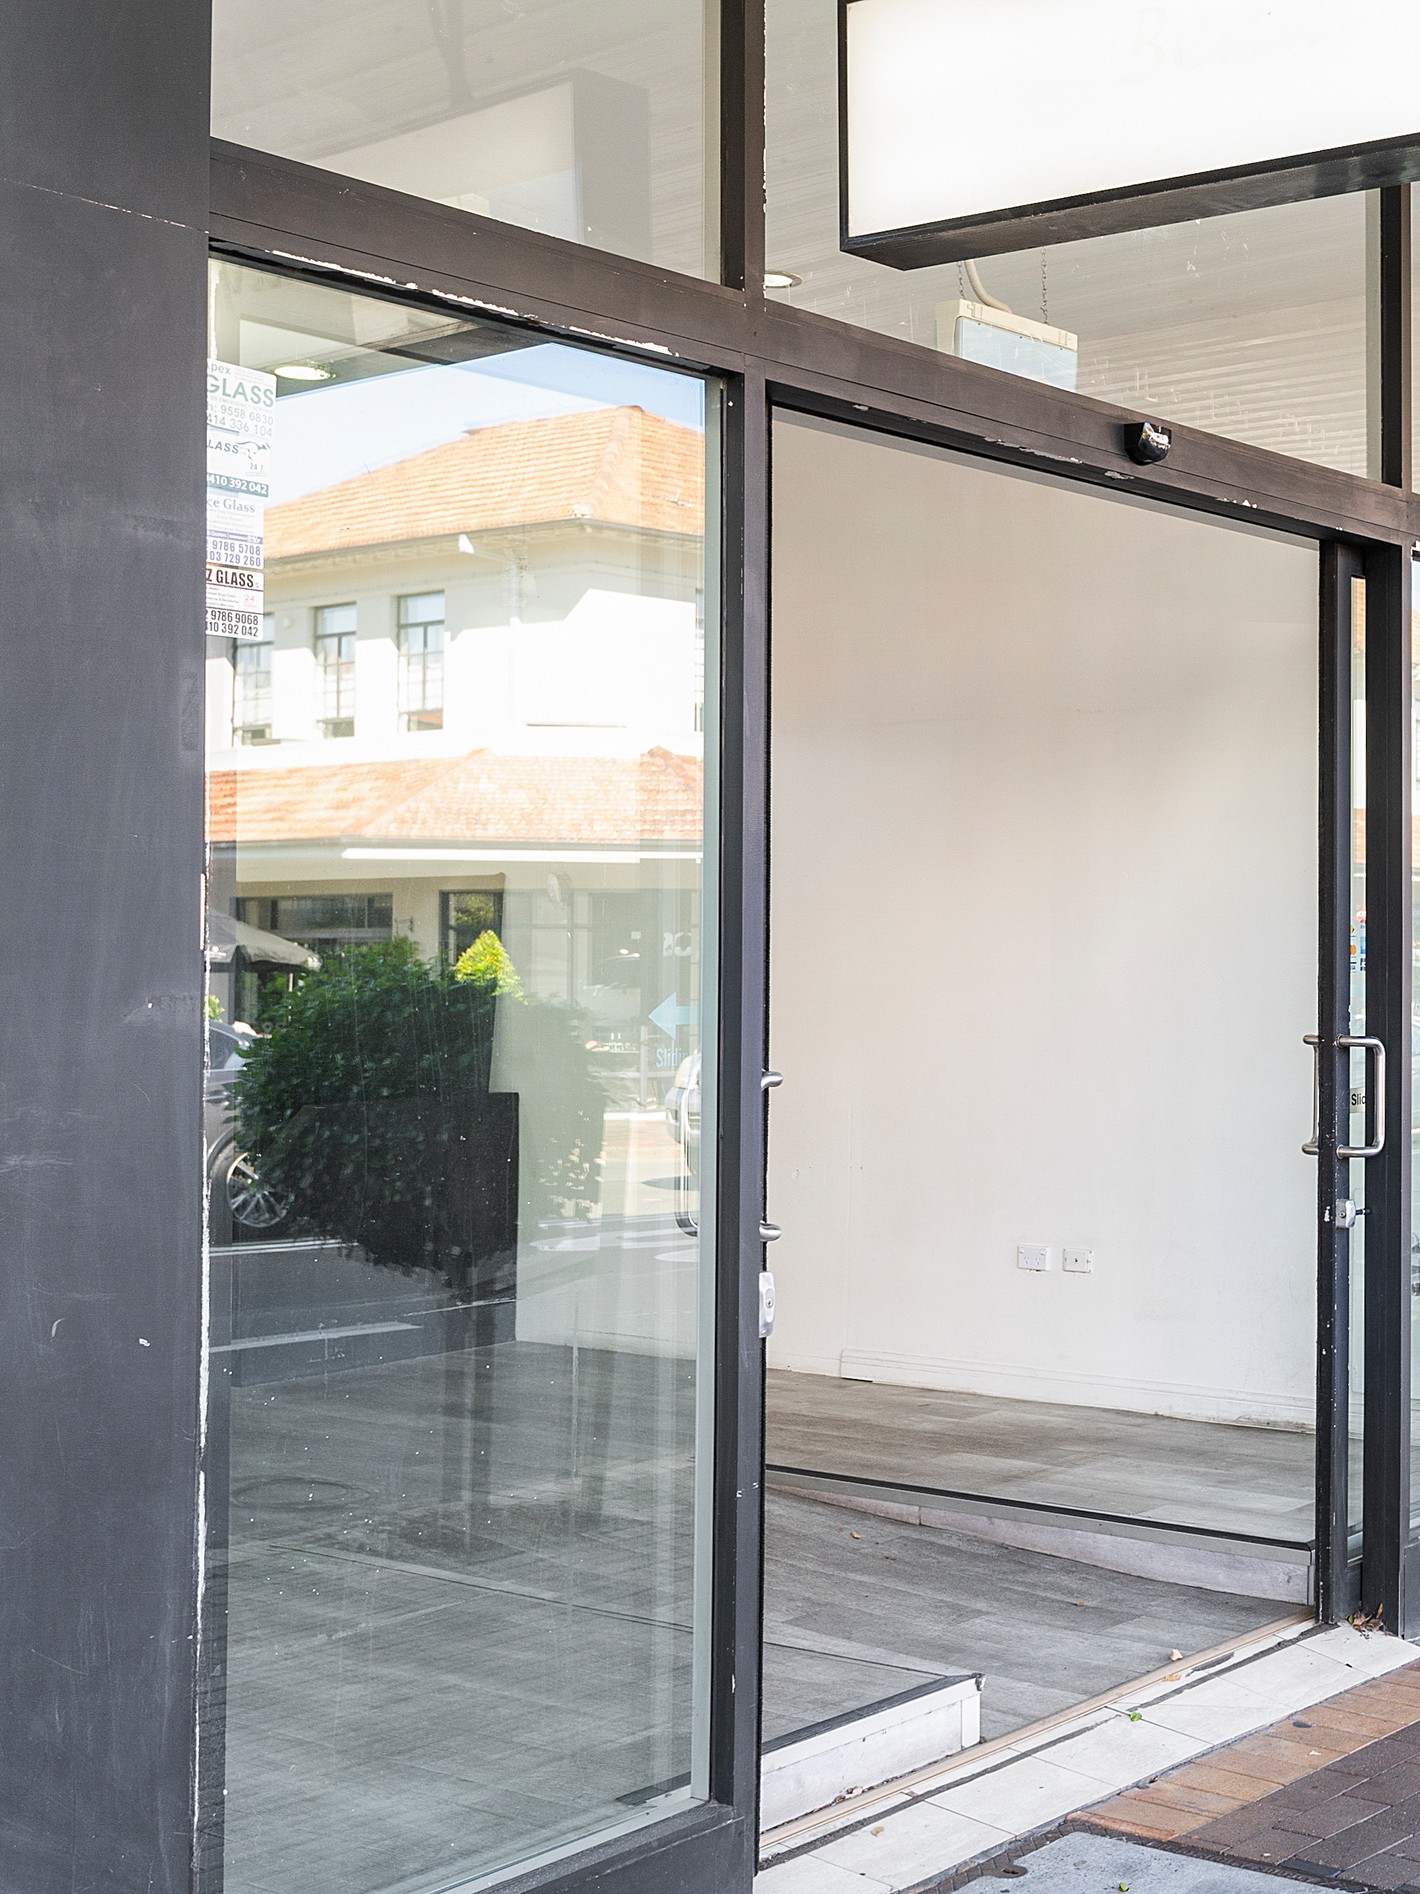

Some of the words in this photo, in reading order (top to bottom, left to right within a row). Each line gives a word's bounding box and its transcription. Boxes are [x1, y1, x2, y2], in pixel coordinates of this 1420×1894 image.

[207, 363, 231, 375] pex
[207, 374, 274, 407] GLASS
[220, 404, 246, 420] 9558
[249, 411, 274, 426] 6830
[207, 413, 226, 426] 414
[229, 418, 250, 433] 336
[254, 424, 273, 437] 104
[207, 439, 239, 454] LASS
[208, 474, 228, 486] 410
[229, 478, 248, 490] 392
[249, 482, 267, 495] 042
[207, 498, 220, 508] ce
[223, 498, 256, 513] Glass
[212, 539, 236, 552] 9786
[238, 543, 261, 556] 5708
[209, 550, 221, 562] 03
[224, 552, 241, 564] 729
[243, 555, 261, 567] 260
[216, 569, 254, 588] GLASS
[210, 610, 233, 622] 9786
[235, 612, 259, 626] 9068
[209, 621, 219, 632] 10
[221, 622, 239, 635] 392
[241, 625, 259, 637] 042
